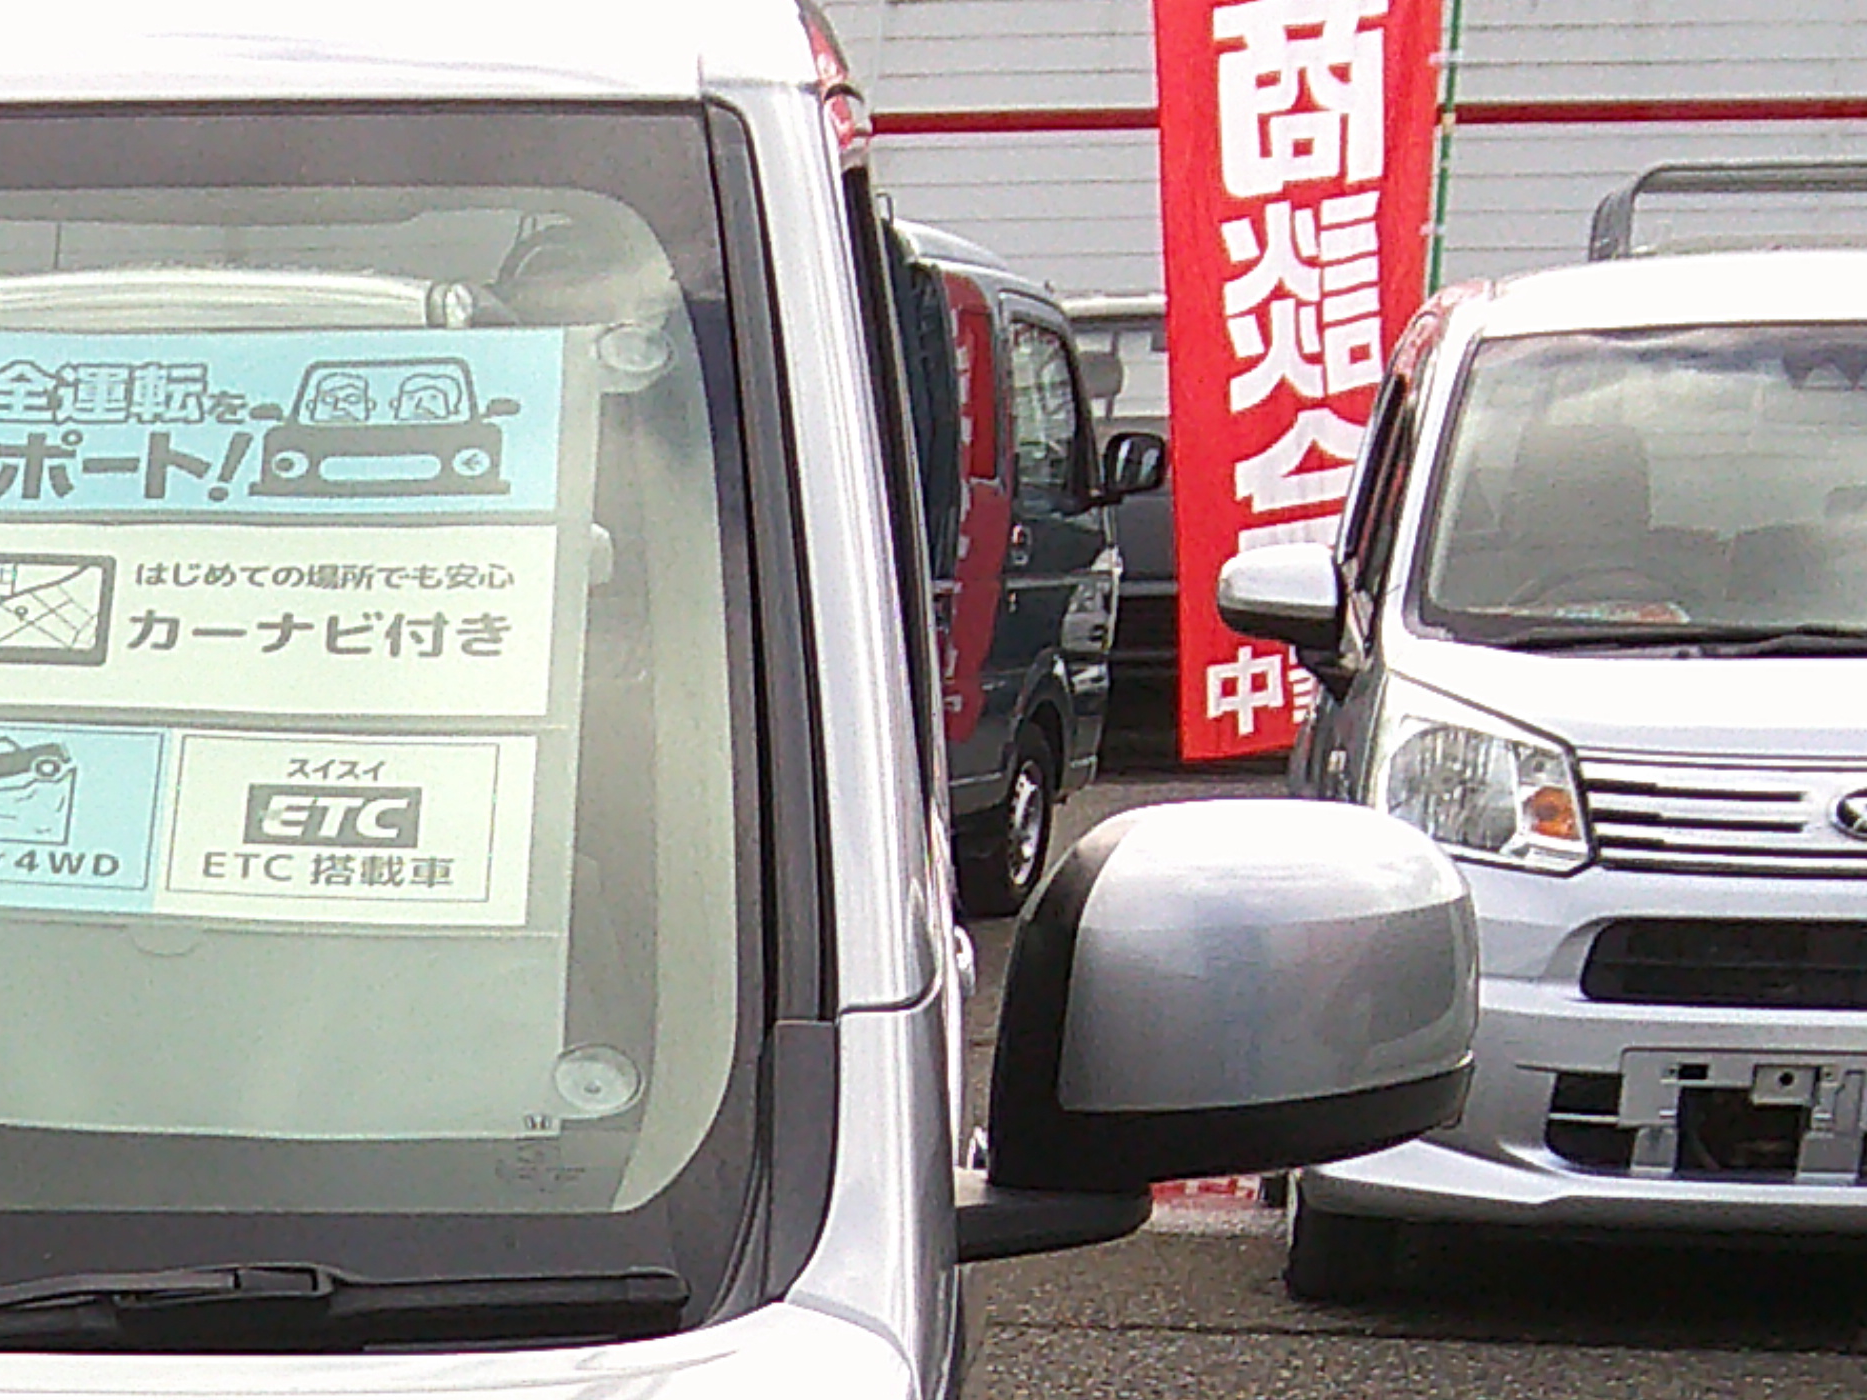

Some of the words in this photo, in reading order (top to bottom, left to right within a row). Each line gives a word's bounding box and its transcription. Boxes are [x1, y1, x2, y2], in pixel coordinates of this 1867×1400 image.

[135, 562, 515, 592] はじめての場所でも安心
[127, 612, 512, 658] カーナビ付き
[286, 757, 384, 782] スイスイ
[260, 794, 409, 840] ETC
[14, 849, 119, 880] 4WD
[203, 851, 292, 884] ETC
[310, 852, 455, 890] 搭載車
